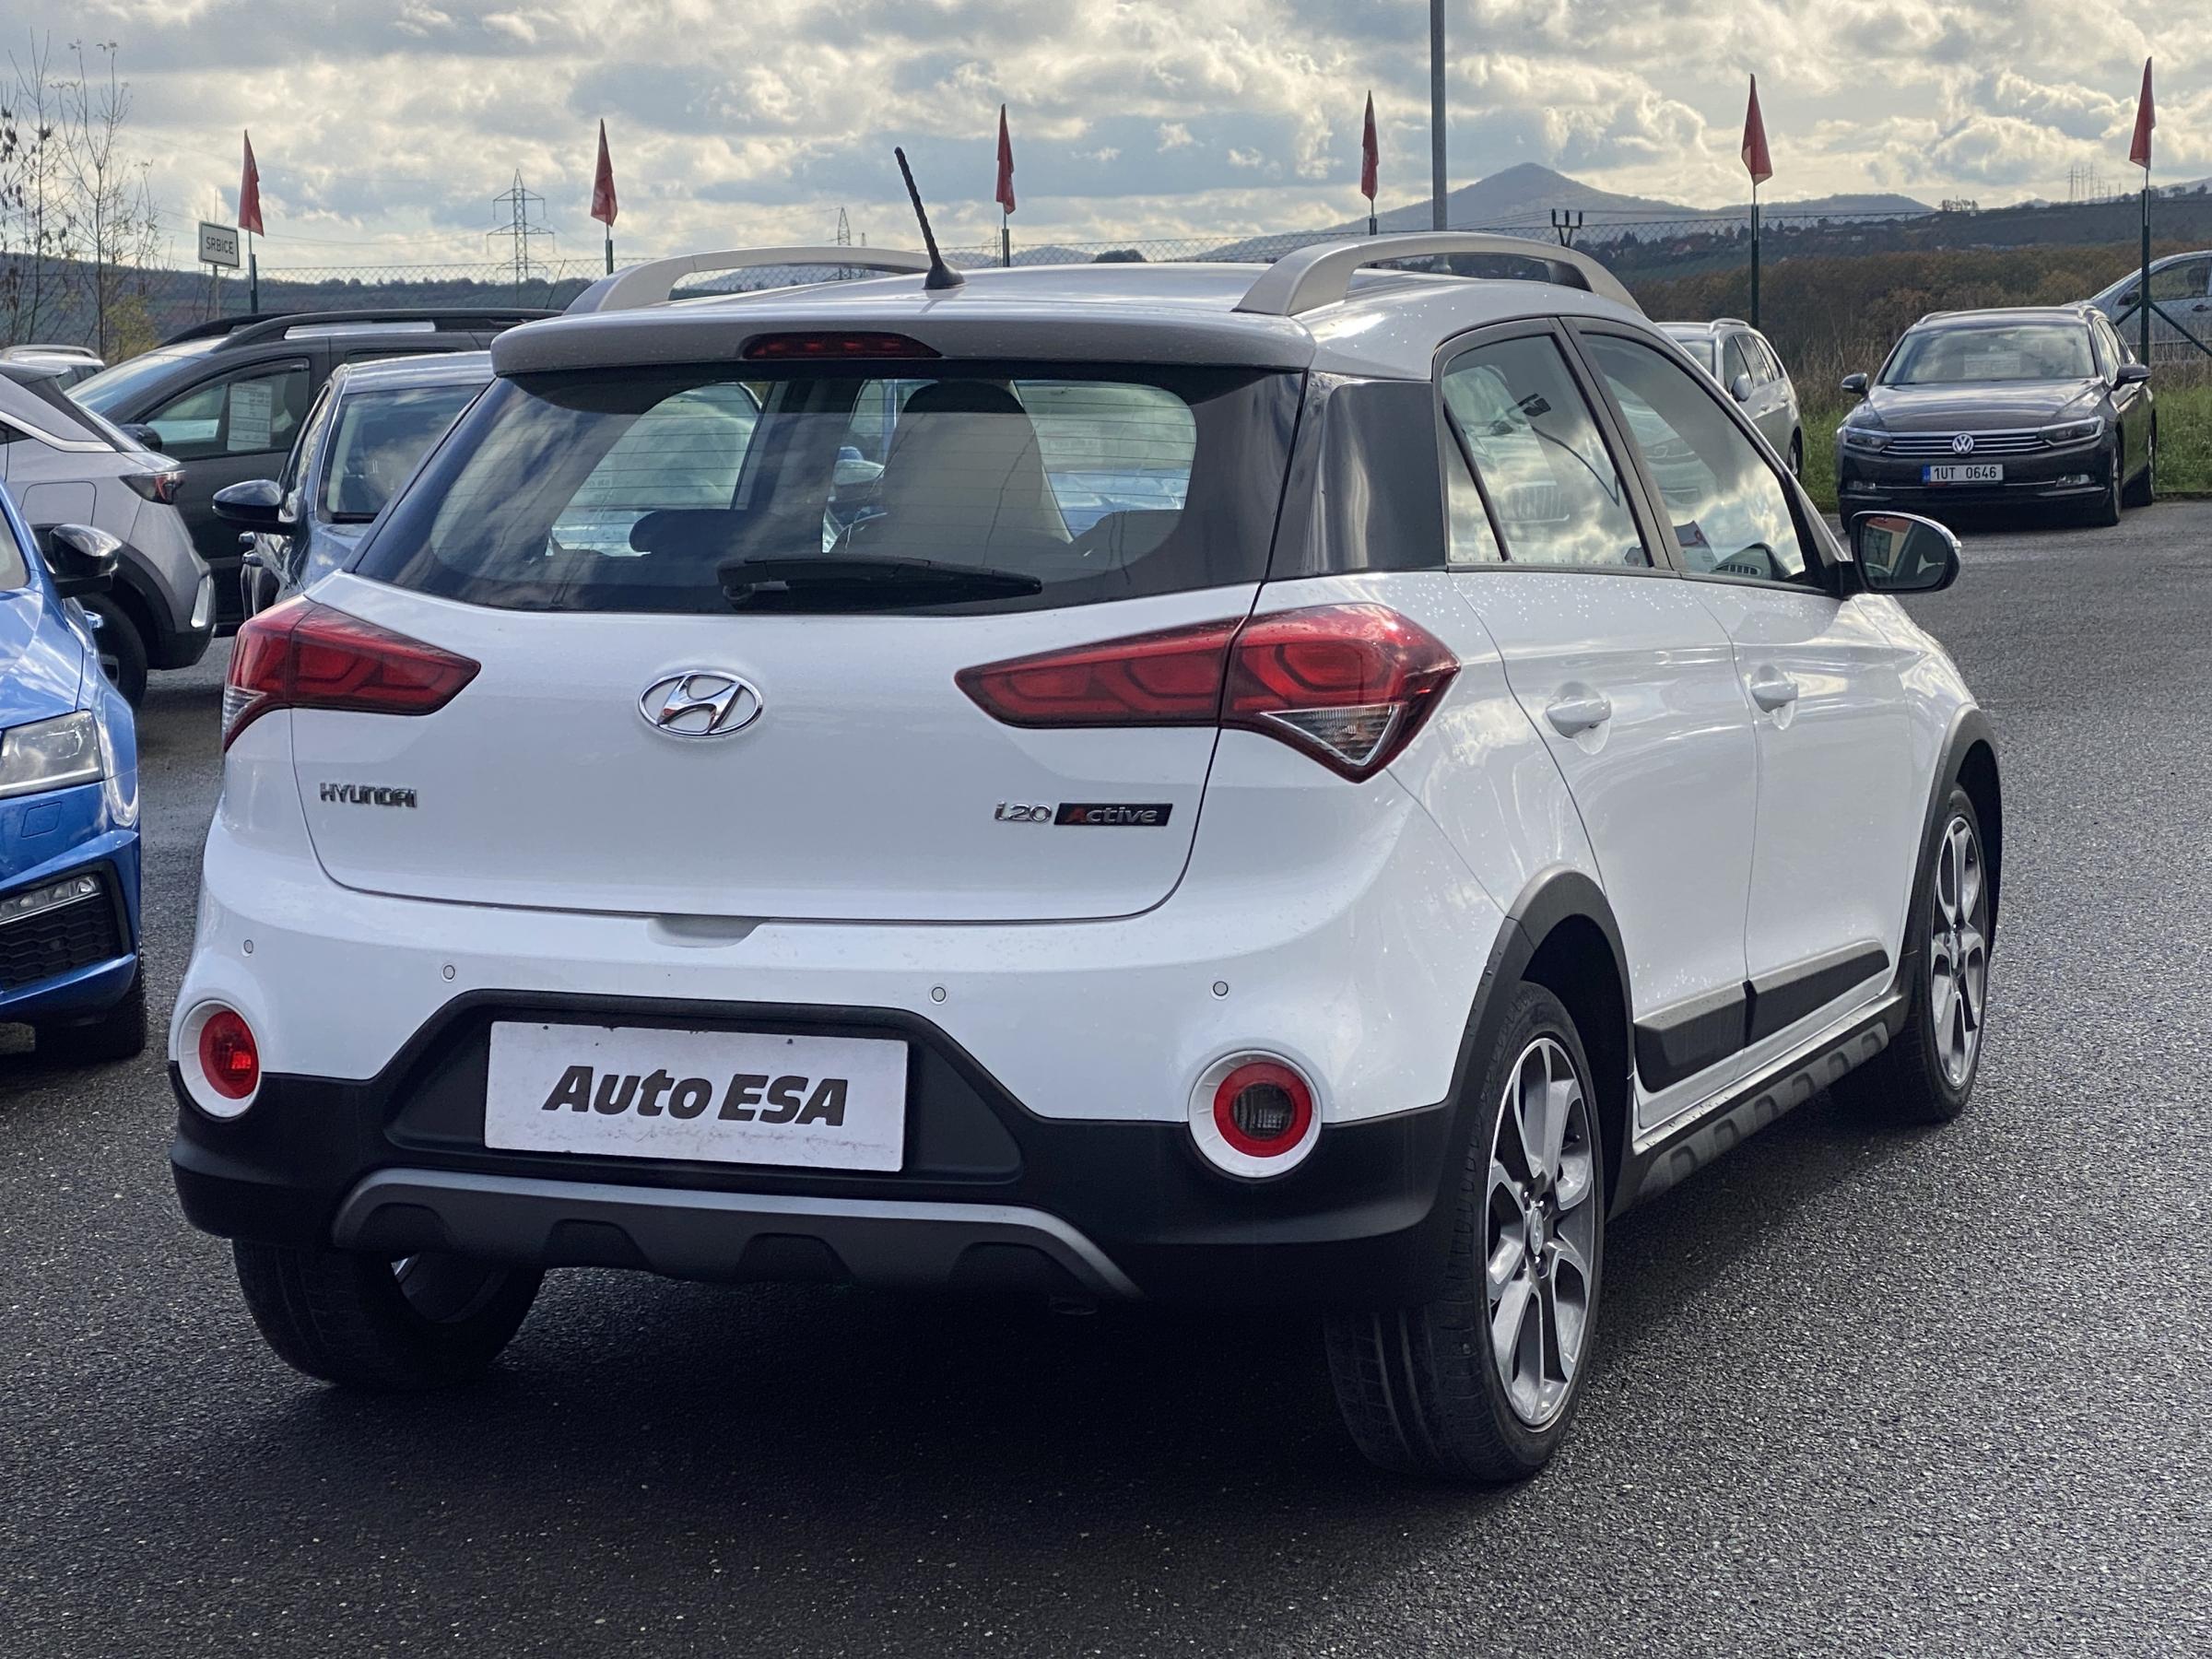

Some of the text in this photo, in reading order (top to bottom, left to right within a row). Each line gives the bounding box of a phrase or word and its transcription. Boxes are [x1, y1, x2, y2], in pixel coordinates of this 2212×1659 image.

[206, 236, 234, 255] SRBICE
[1934, 466, 1956, 480] 1UT
[1965, 466, 1997, 479] 0646
[319, 782, 418, 808] HYUNDAI
[994, 800, 1159, 824] i20 Active
[542, 1065, 848, 1127] Auto ESA
